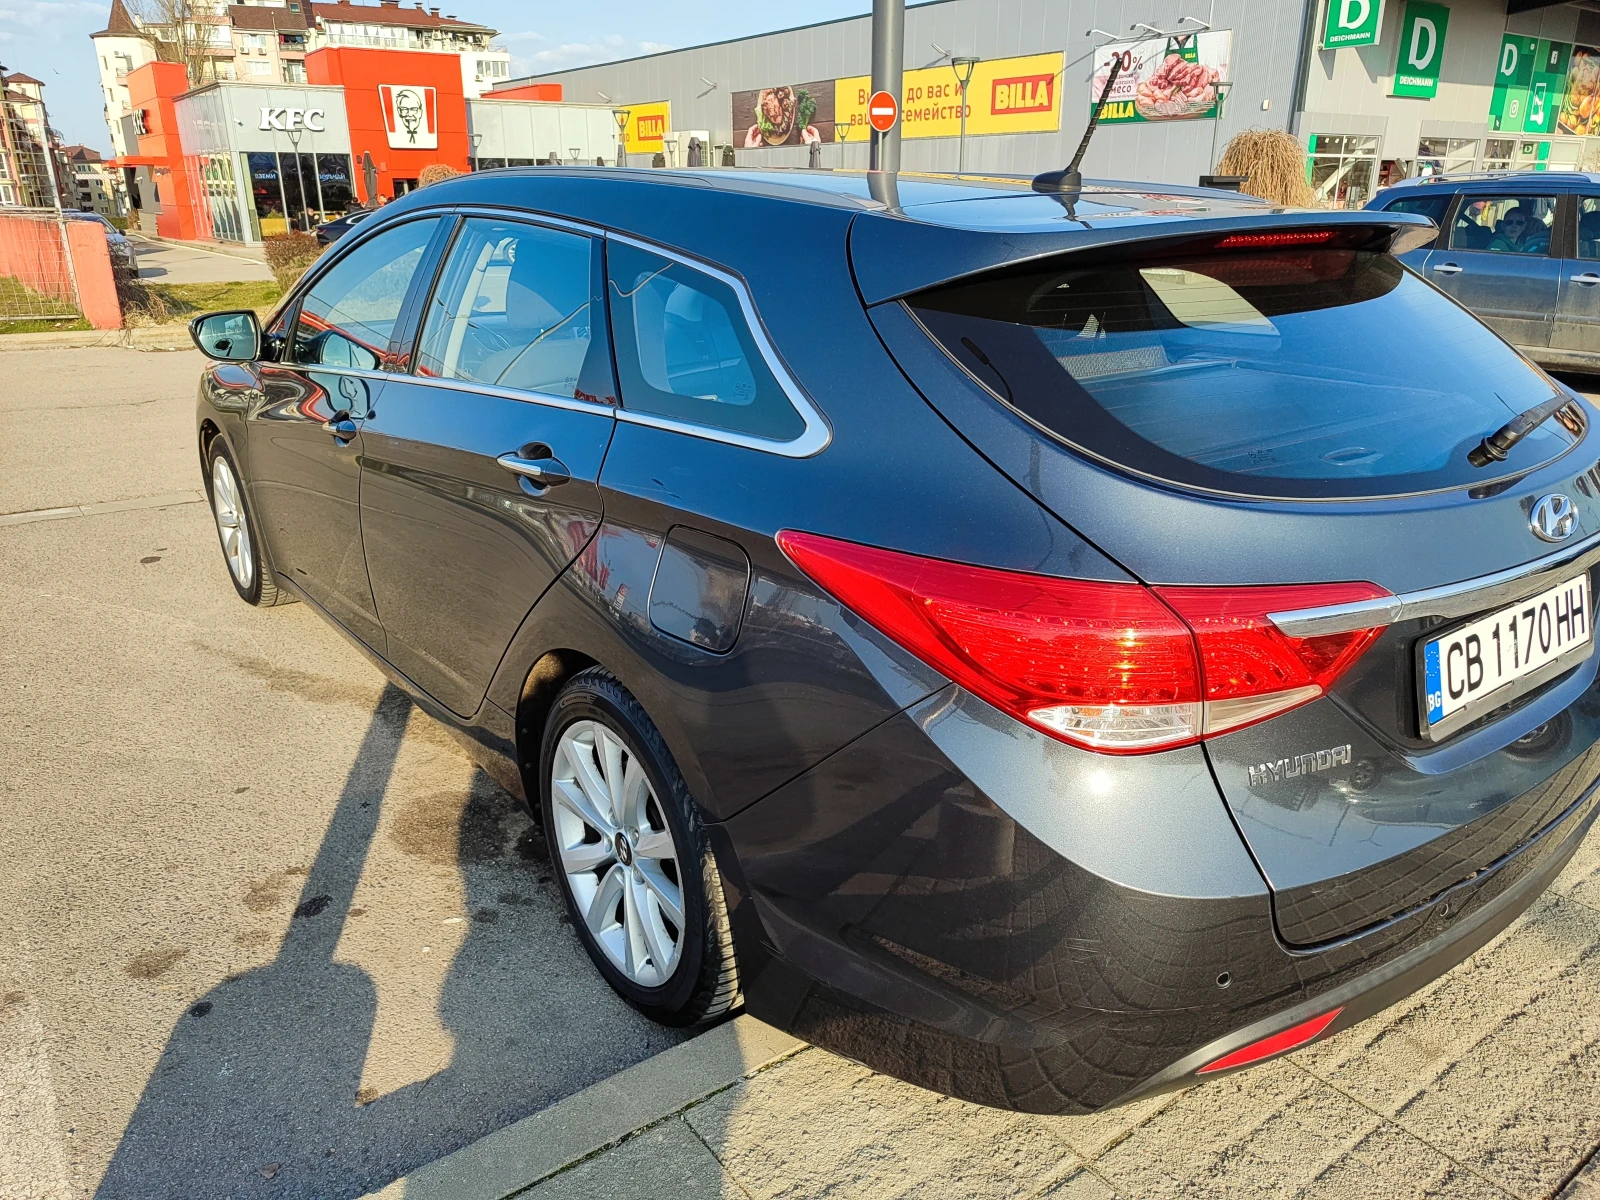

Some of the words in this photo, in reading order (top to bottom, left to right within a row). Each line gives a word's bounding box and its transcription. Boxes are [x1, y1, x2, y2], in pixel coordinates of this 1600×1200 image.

[1338, 0, 1371, 29] D
[1329, 31, 1371, 43] DEICHMANN
[1407, 17, 1437, 71] D
[1501, 43, 1518, 76] D
[907, 87, 923, 104] до
[927, 84, 950, 99] вас
[1399, 75, 1434, 88] DEICHMANN
[995, 80, 1049, 110] BILLA
[258, 107, 325, 132] KFC
[1099, 101, 1134, 119] BILLA
[638, 119, 664, 138] BILLA
[1446, 633, 1484, 700] CB
[1492, 602, 1551, 677] 1170
[1555, 583, 1586, 647] HH
[1428, 690, 1442, 711] BG
[1248, 743, 1352, 787] HYUNDAI
